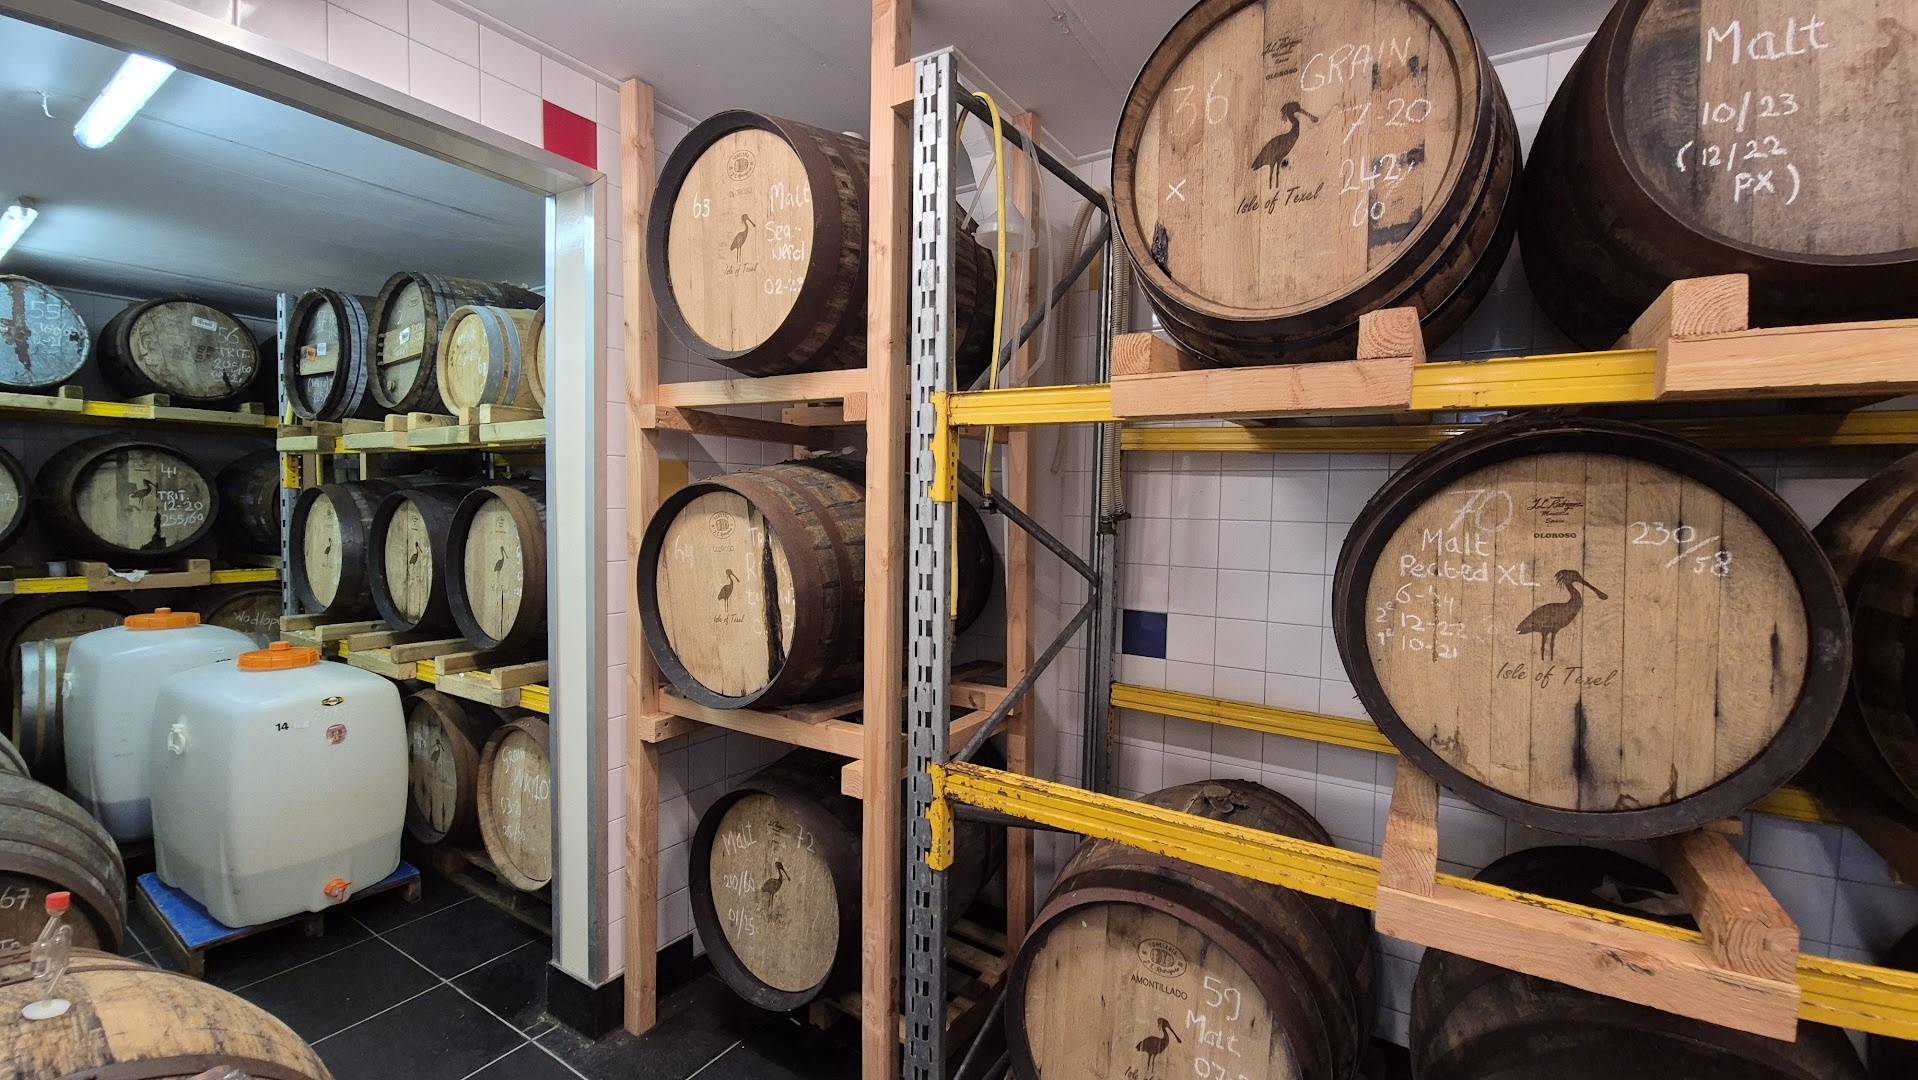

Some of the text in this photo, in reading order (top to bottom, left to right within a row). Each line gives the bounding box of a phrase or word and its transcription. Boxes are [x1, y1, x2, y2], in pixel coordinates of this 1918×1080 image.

[1706, 14, 1829, 65] Malt
[1300, 37, 1412, 93] GRAIN
[1169, 73, 1230, 138] 36
[1338, 98, 1431, 144] 7-20
[1702, 91, 1800, 133] 10/23
[1676, 135, 1788, 172] (12/22
[692, 193, 710, 218] 63
[770, 181, 811, 212] Malt
[1236, 181, 1325, 214] Isle of Texel
[30, 300, 61, 319] 55
[218, 326, 240, 344] 56
[161, 510, 204, 526] 255/60
[163, 500, 203, 511] 12-20
[1447, 489, 1513, 533] 70
[1421, 528, 1490, 556] Malt
[1400, 554, 1541, 587] Peated XL
[1496, 661, 1618, 689] Isle of Texel
[275, 721, 289, 732] 14
[0, 886, 31, 911] 67
[1130, 973, 1188, 1000] AMONTILLADO
[1203, 975, 1241, 1020] 59
[1186, 1009, 1241, 1058] Malt
